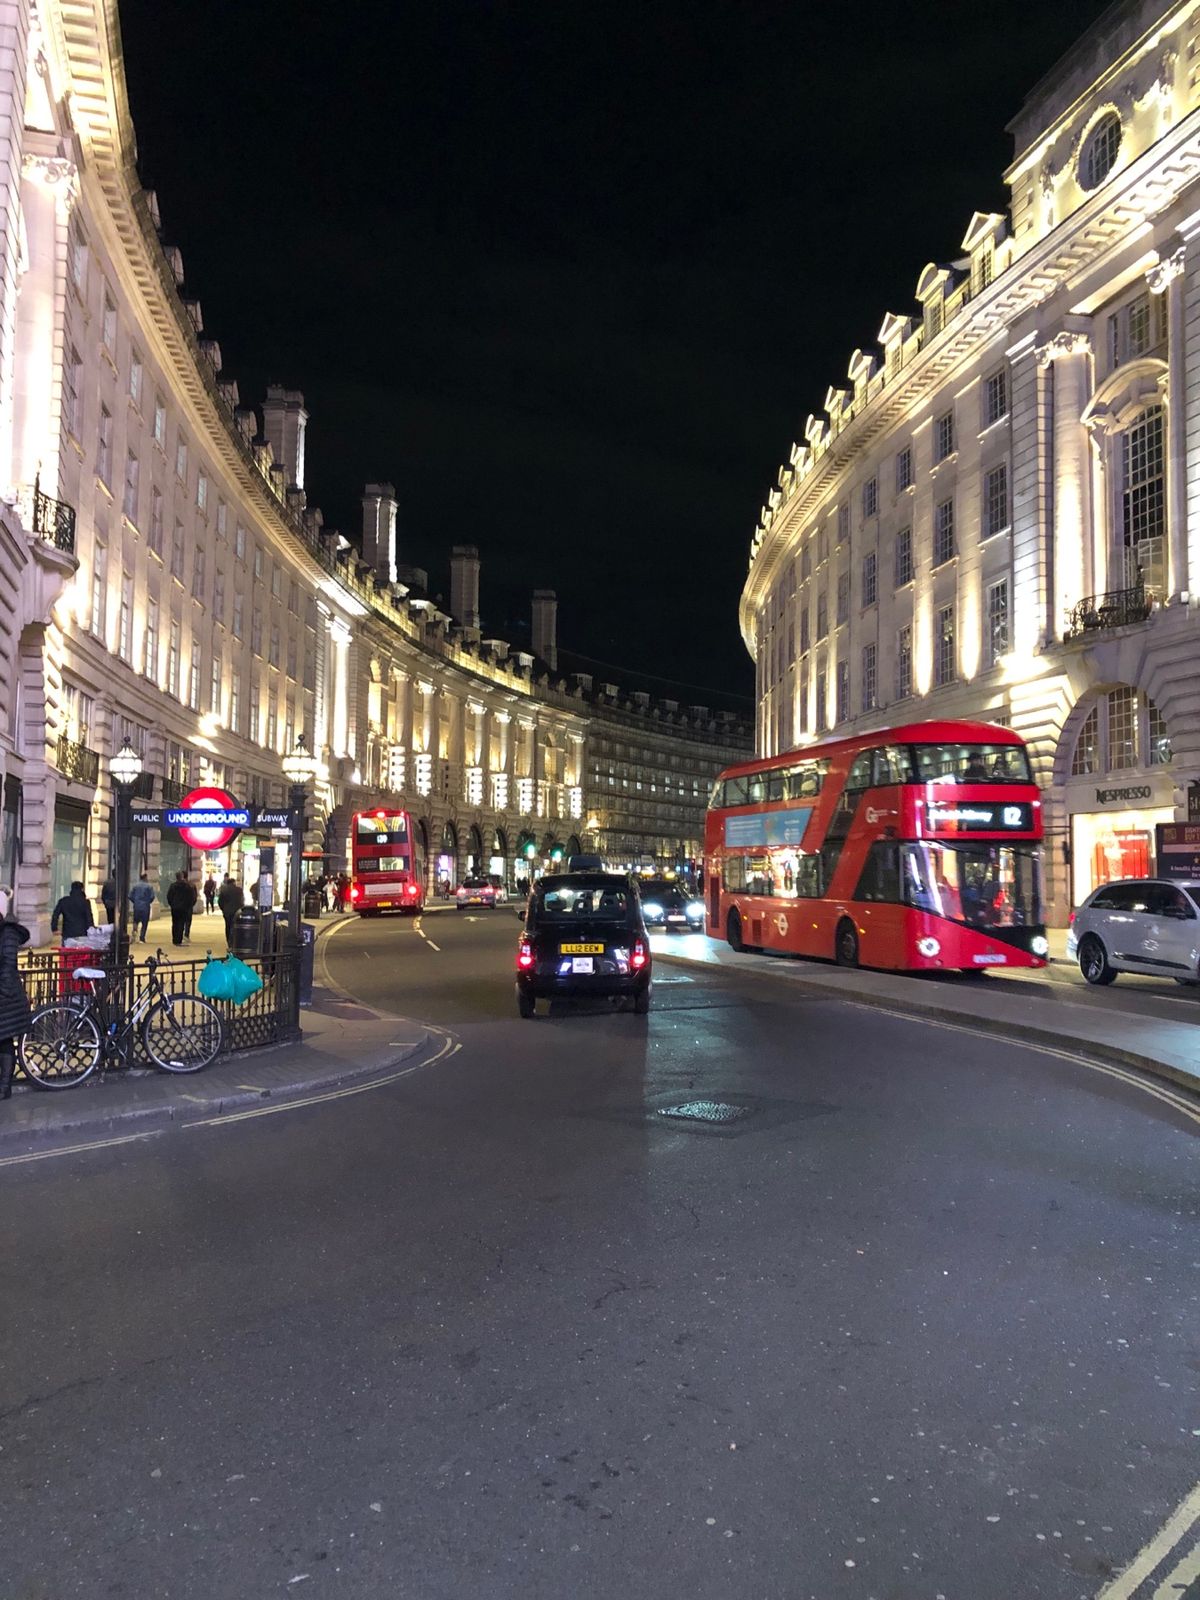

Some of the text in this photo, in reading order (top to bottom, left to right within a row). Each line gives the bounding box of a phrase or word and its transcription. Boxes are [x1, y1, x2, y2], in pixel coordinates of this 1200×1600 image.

[1095, 785, 1151, 804] NESPRESSO
[133, 814, 160, 823] PUBLIC
[168, 813, 247, 824] UNDERGROUND
[257, 814, 289, 823] SUBWAY
[1003, 806, 1022, 825] 12
[565, 944, 583, 953] LL12
